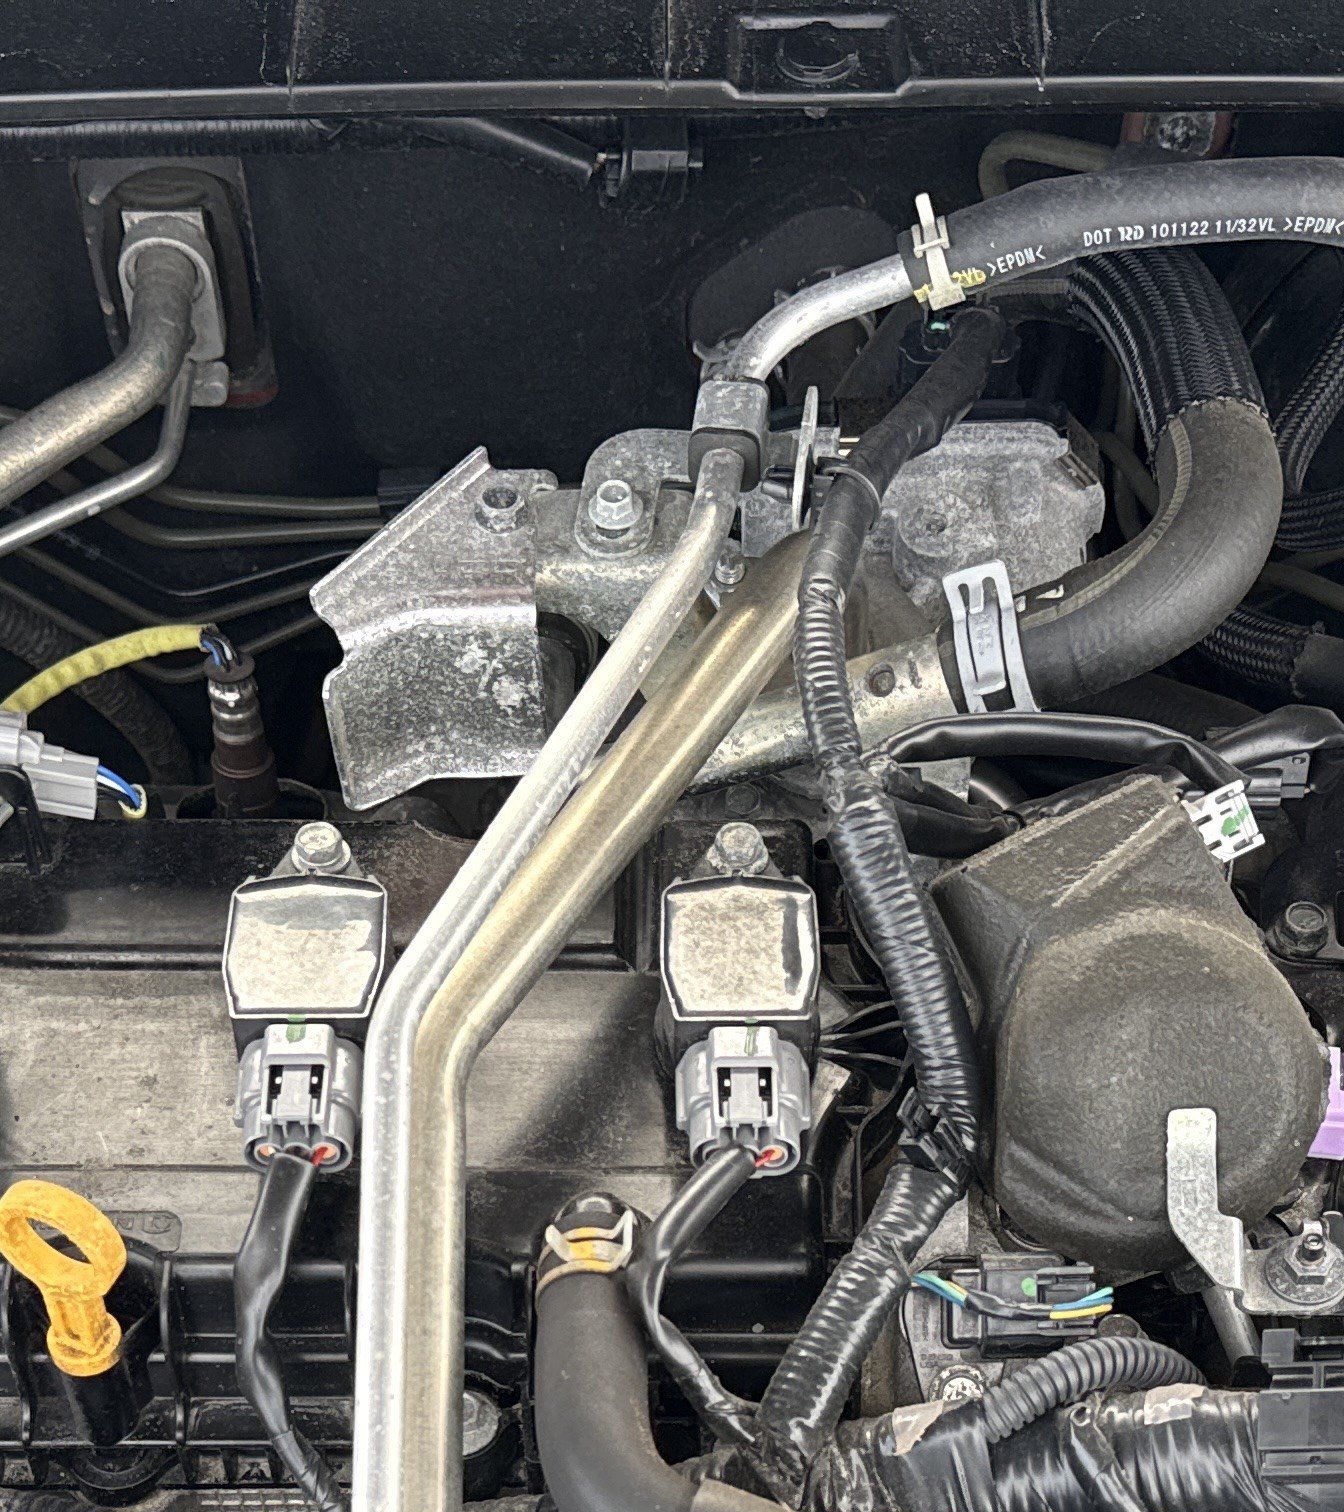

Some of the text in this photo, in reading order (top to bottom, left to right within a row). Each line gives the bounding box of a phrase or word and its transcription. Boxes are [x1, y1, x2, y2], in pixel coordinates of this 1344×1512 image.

[1083, 228, 1112, 247] DOT
[1150, 220, 1209, 238] 101122
[1215, 217, 1276, 234] 11/32VL
